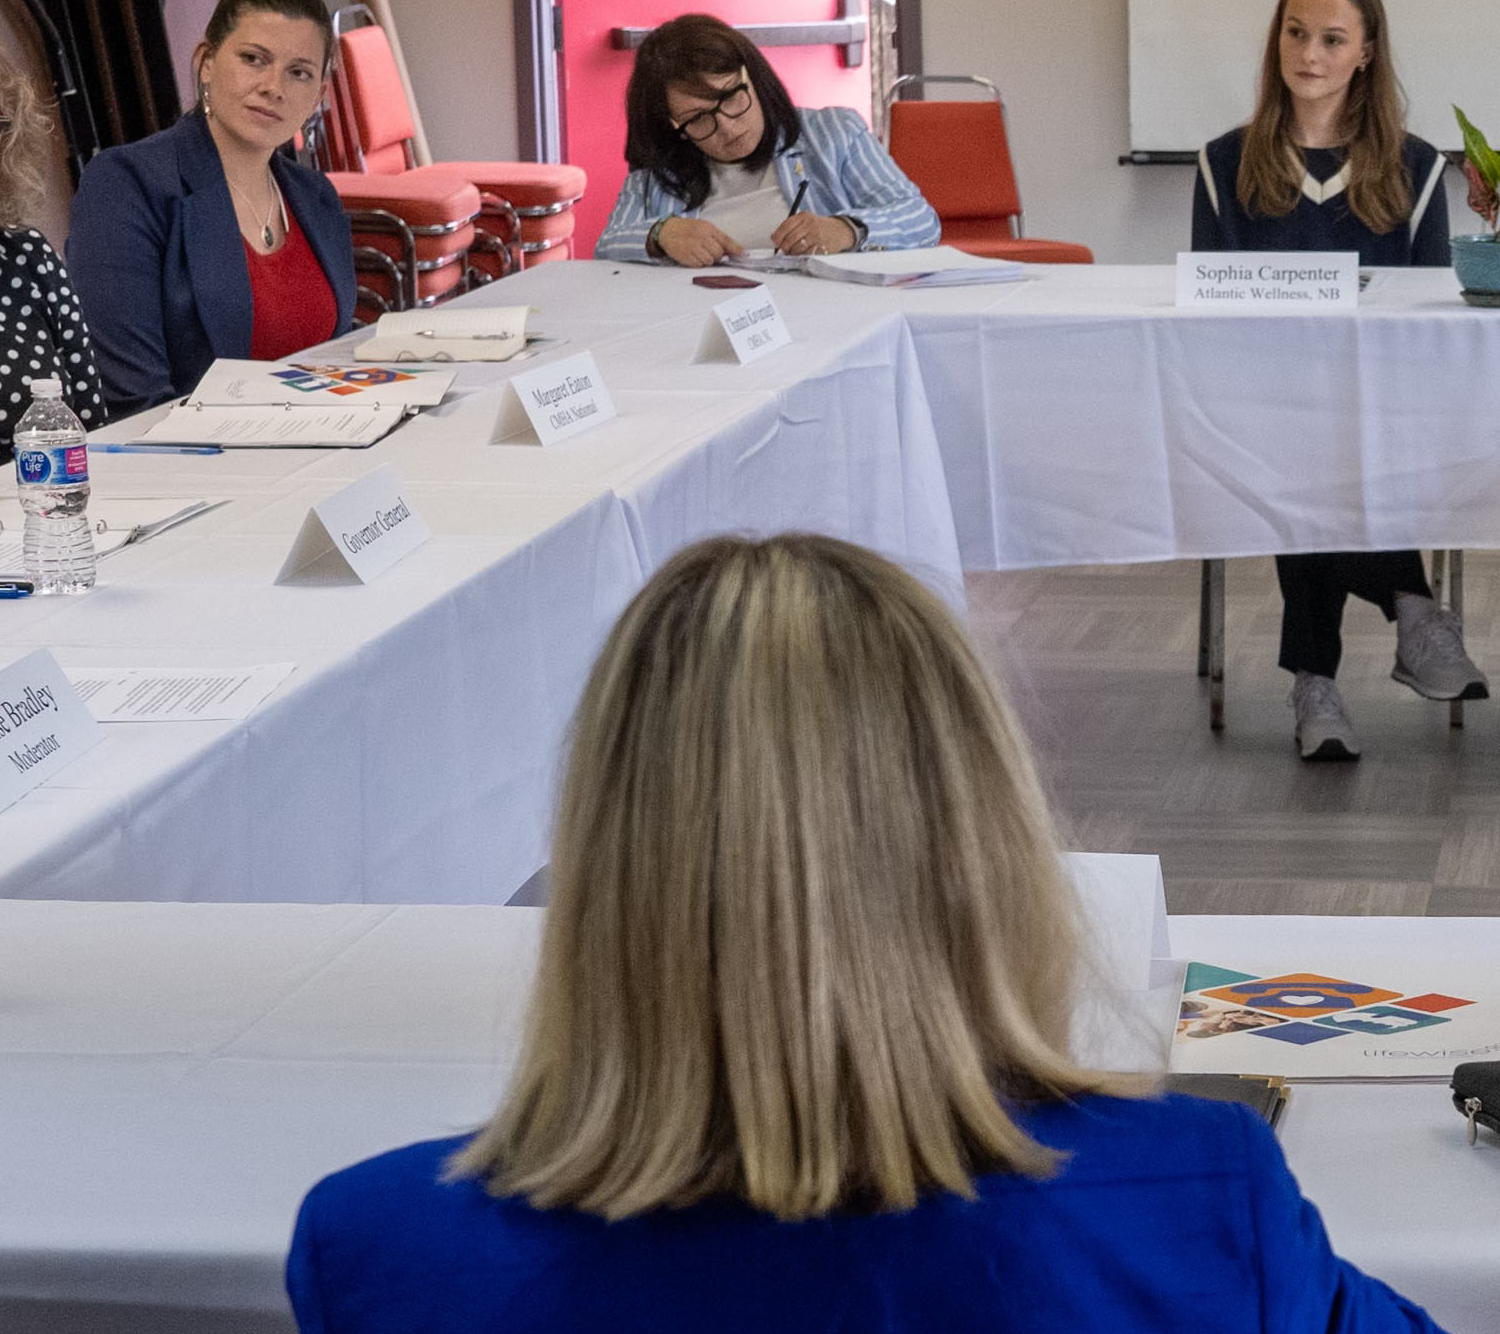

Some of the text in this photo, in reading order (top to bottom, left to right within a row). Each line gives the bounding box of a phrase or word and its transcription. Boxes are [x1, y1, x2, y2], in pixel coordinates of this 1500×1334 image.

[1196, 265, 1340, 284] Sophia Carpenter
[1194, 287, 1340, 301] Atlantic Wellness, NB
[532, 376, 593, 408] Margaret Eaton
[22, 451, 45, 463] Pure
[342, 496, 411, 554] Governor General
[0, 685, 59, 728] Bradley
[7, 733, 61, 774] Moderator
